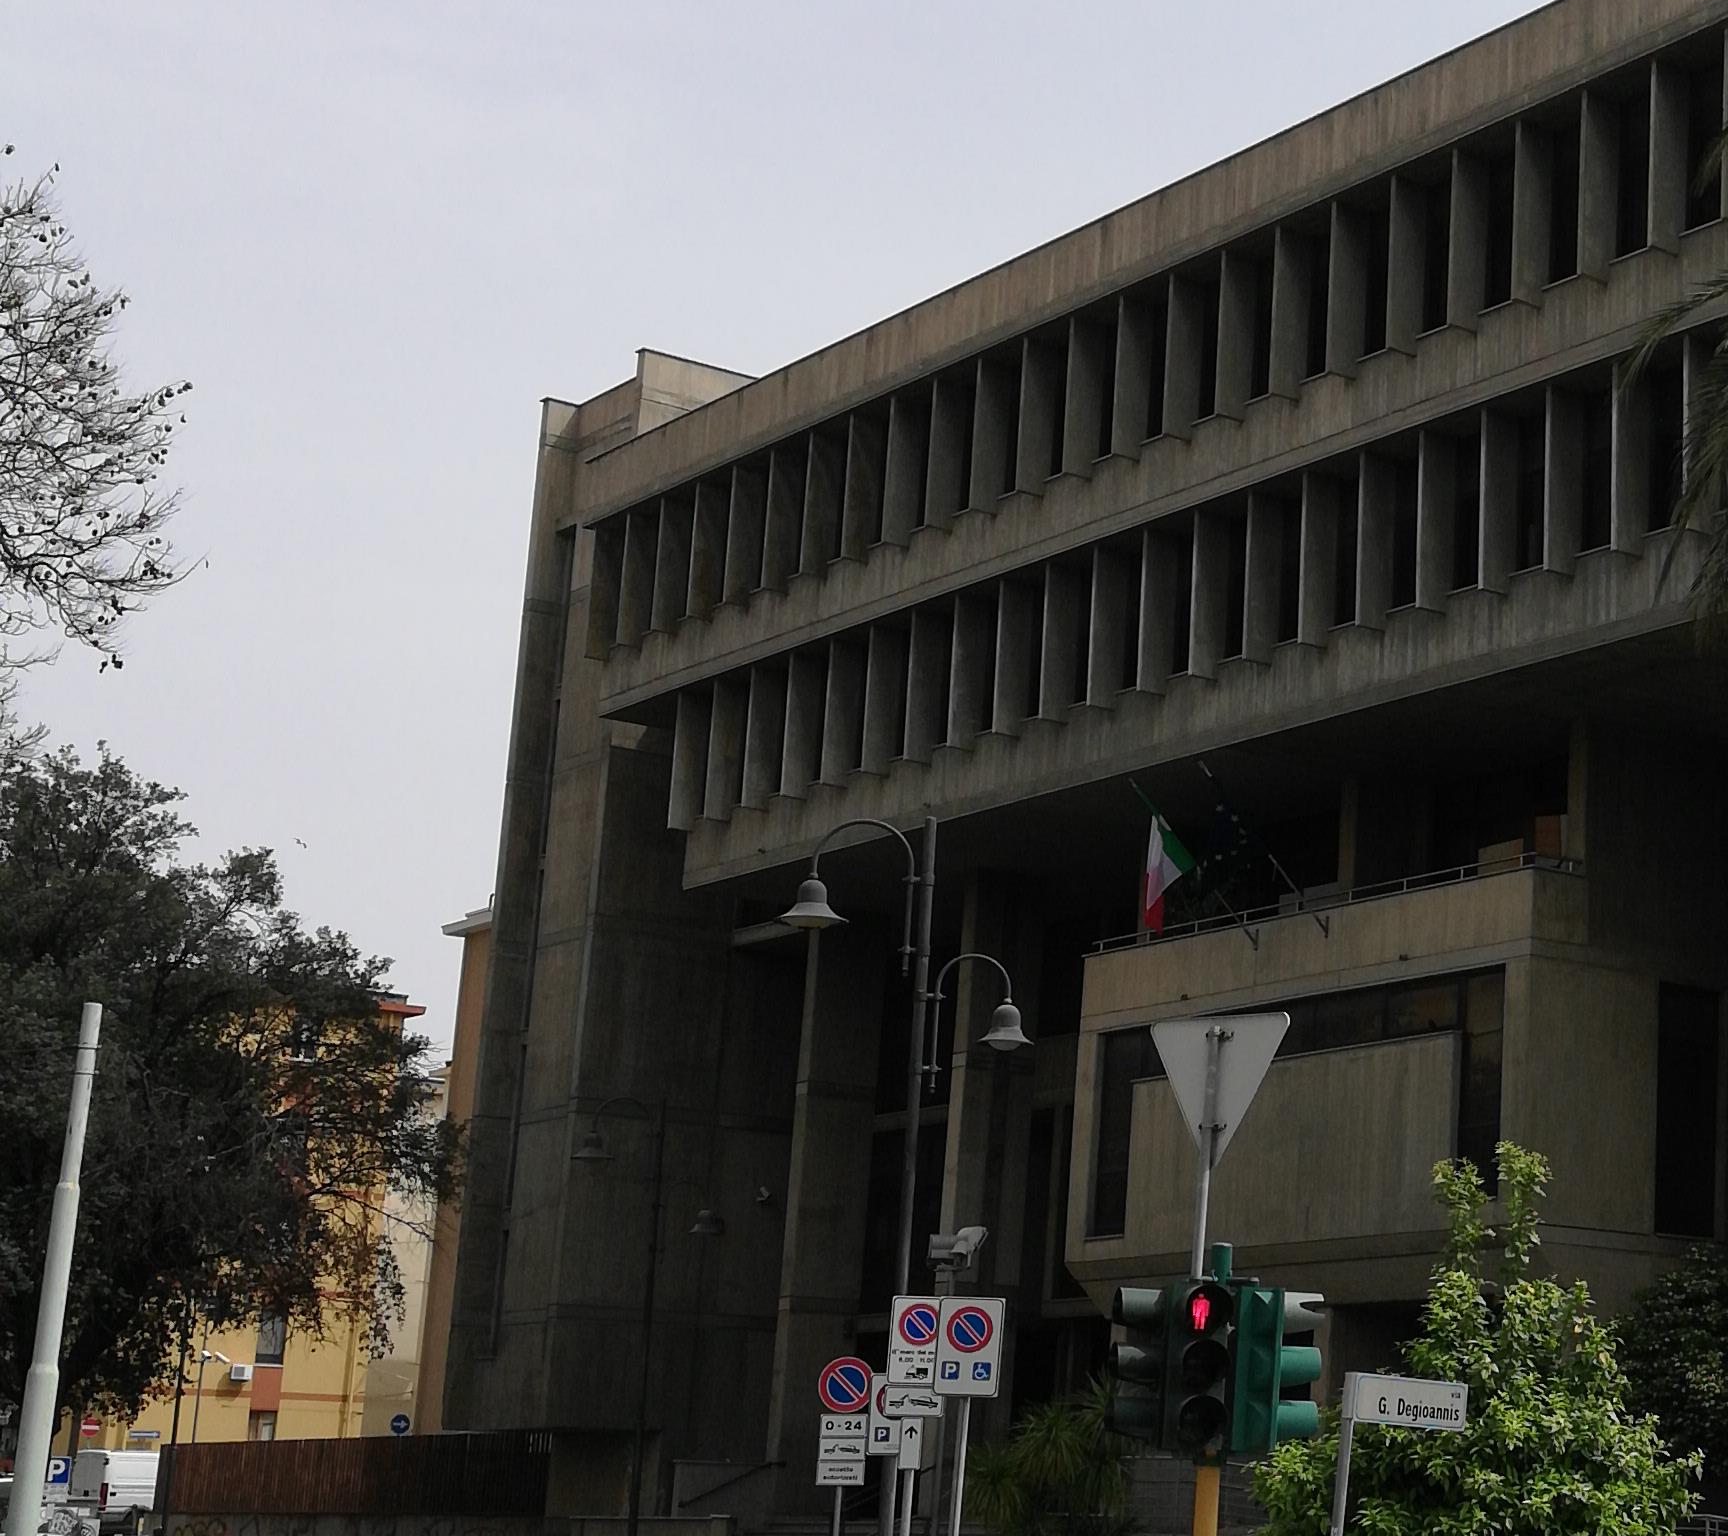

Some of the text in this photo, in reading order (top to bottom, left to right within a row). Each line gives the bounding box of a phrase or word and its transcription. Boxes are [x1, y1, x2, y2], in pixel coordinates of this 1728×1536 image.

[945, 1363, 956, 1378] P
[1450, 1391, 1461, 1399] via
[1378, 1396, 1460, 1422] G. Degioannis
[877, 1429, 887, 1440] P
[47, 1459, 65, 1482] P
